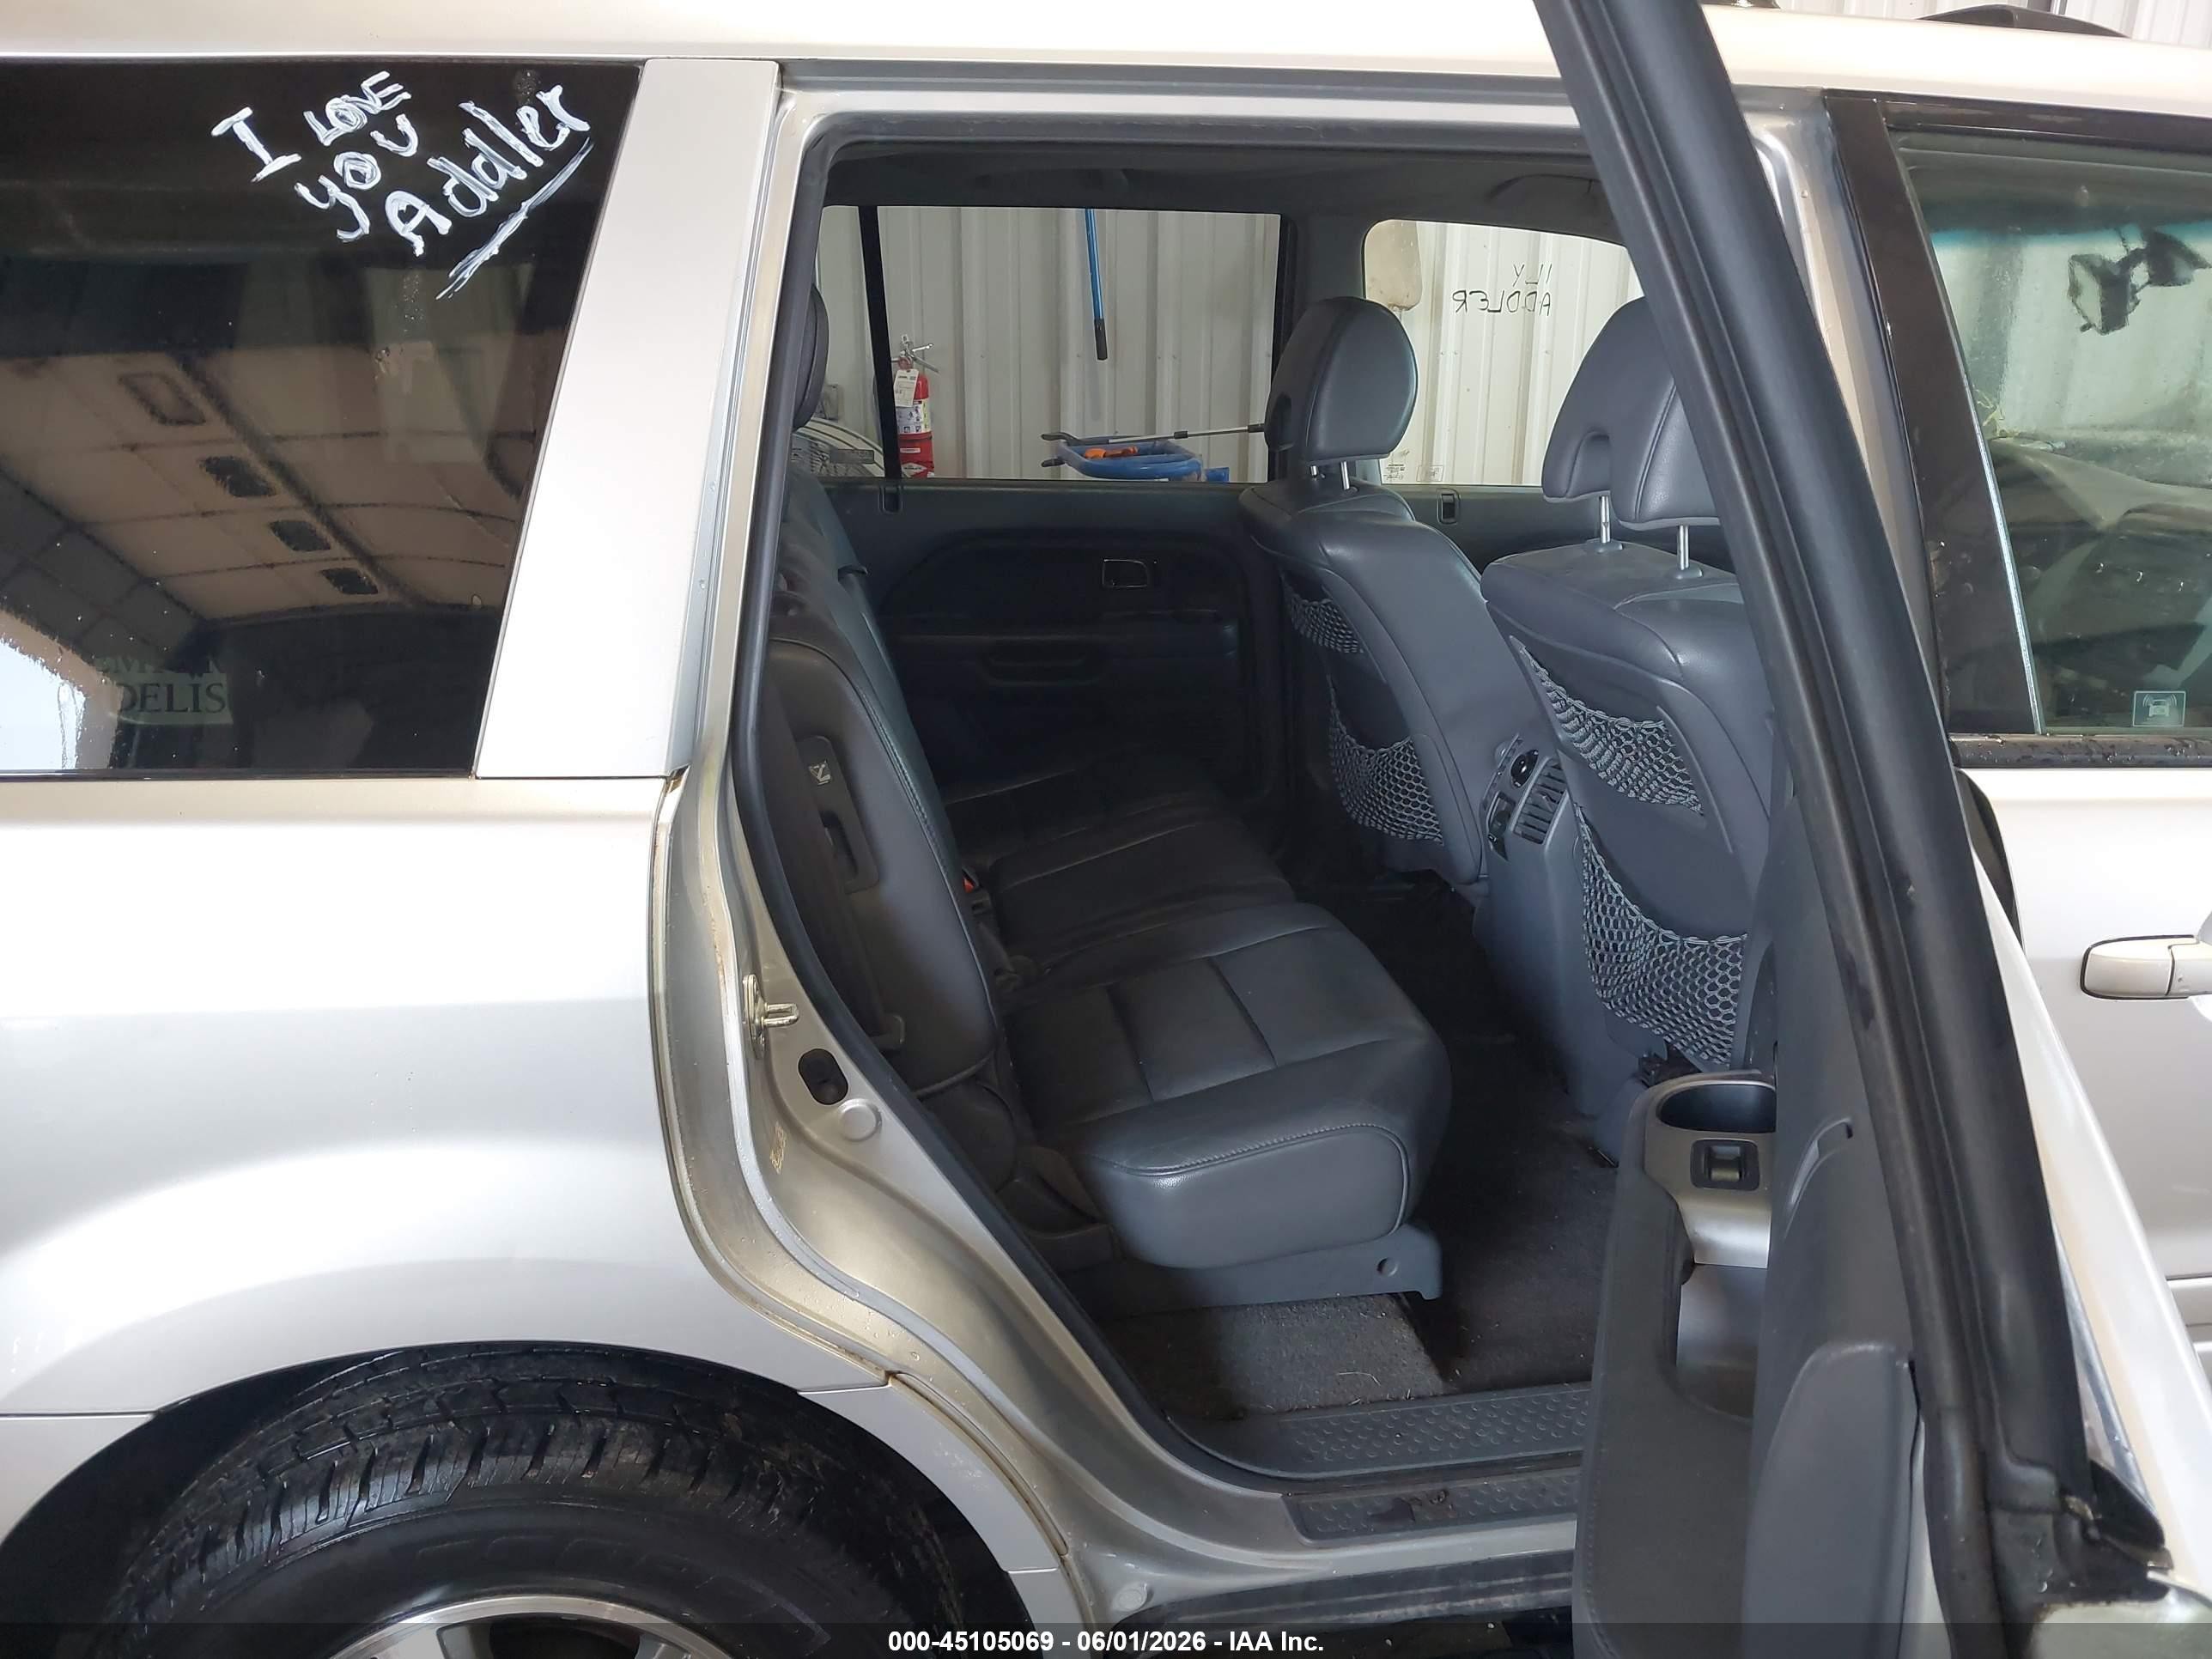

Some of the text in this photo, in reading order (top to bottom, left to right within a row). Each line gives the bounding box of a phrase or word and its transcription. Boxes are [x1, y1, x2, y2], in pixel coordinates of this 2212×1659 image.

[210, 70, 412, 183] I LOVE
[385, 84, 591, 257] Addler
